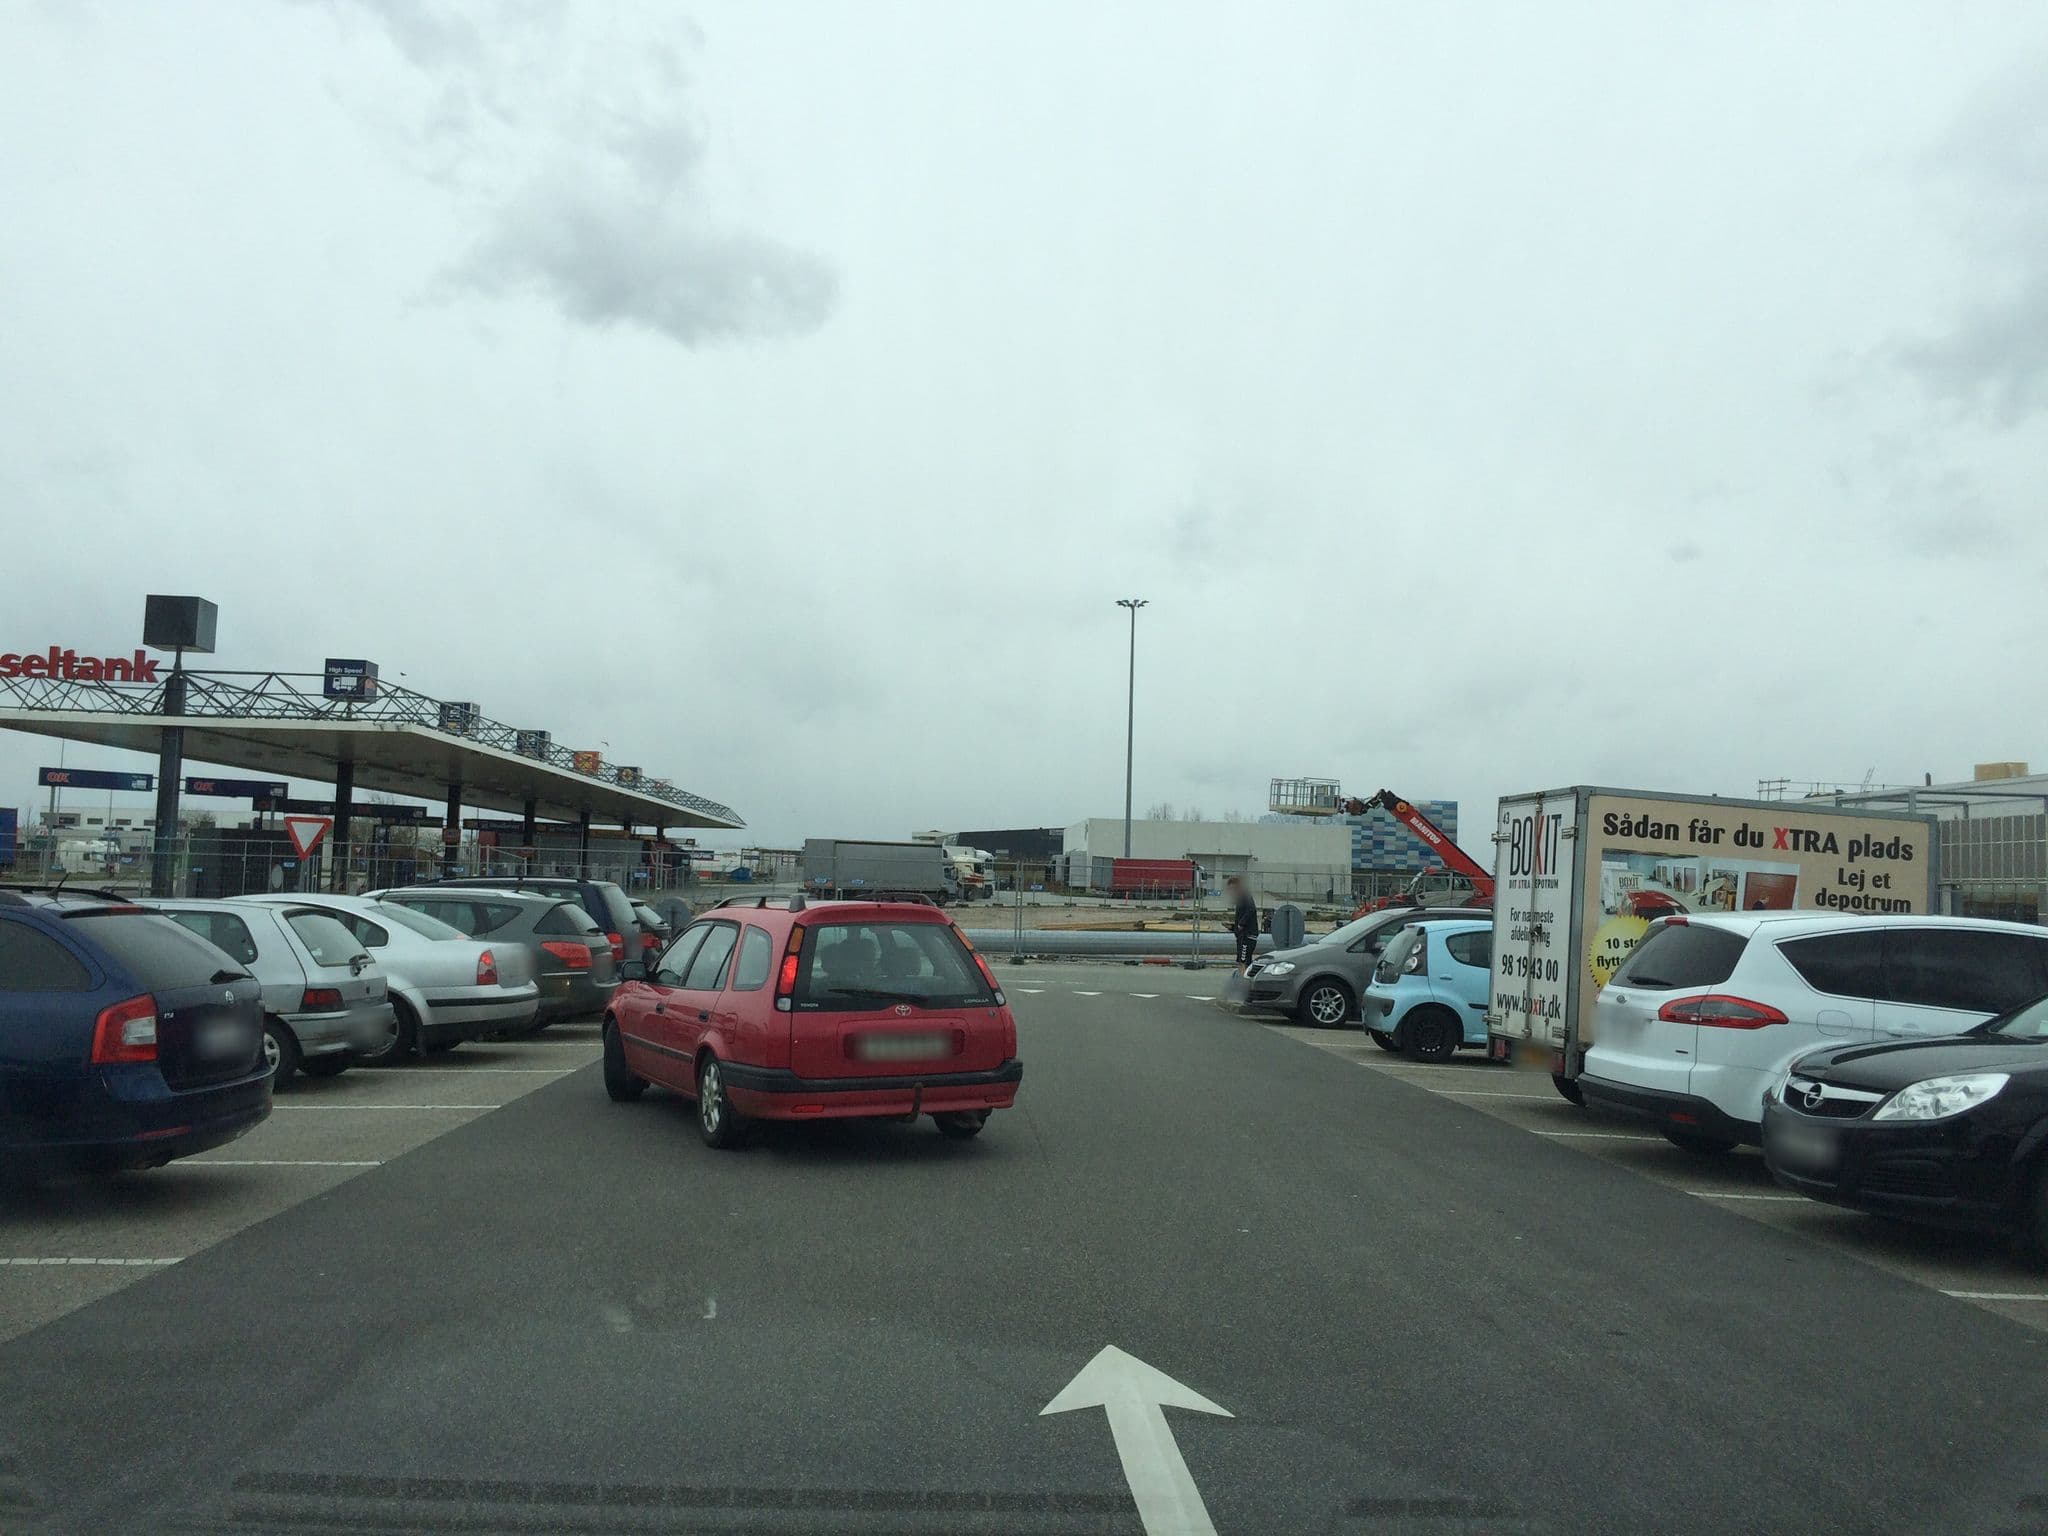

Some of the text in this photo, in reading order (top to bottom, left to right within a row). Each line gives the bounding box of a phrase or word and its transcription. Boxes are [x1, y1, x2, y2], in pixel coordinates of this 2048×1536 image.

[329, 666, 363, 675] High Speed
[1409, 816, 1441, 845] MANITOU
[1603, 812, 1914, 863] Sådan får du XTRA plads
[1510, 813, 1562, 877] BOXIT
[1532, 879, 1558, 889] EPOTRUM
[1838, 867, 1892, 892] Lej et
[1814, 887, 1912, 913] depotrum
[1510, 907, 1521, 921] For
[1605, 937, 1620, 949] 10
[1502, 954, 1559, 982] 98 19 43 00
[1496, 989, 1561, 1019] www.boxit.dk
